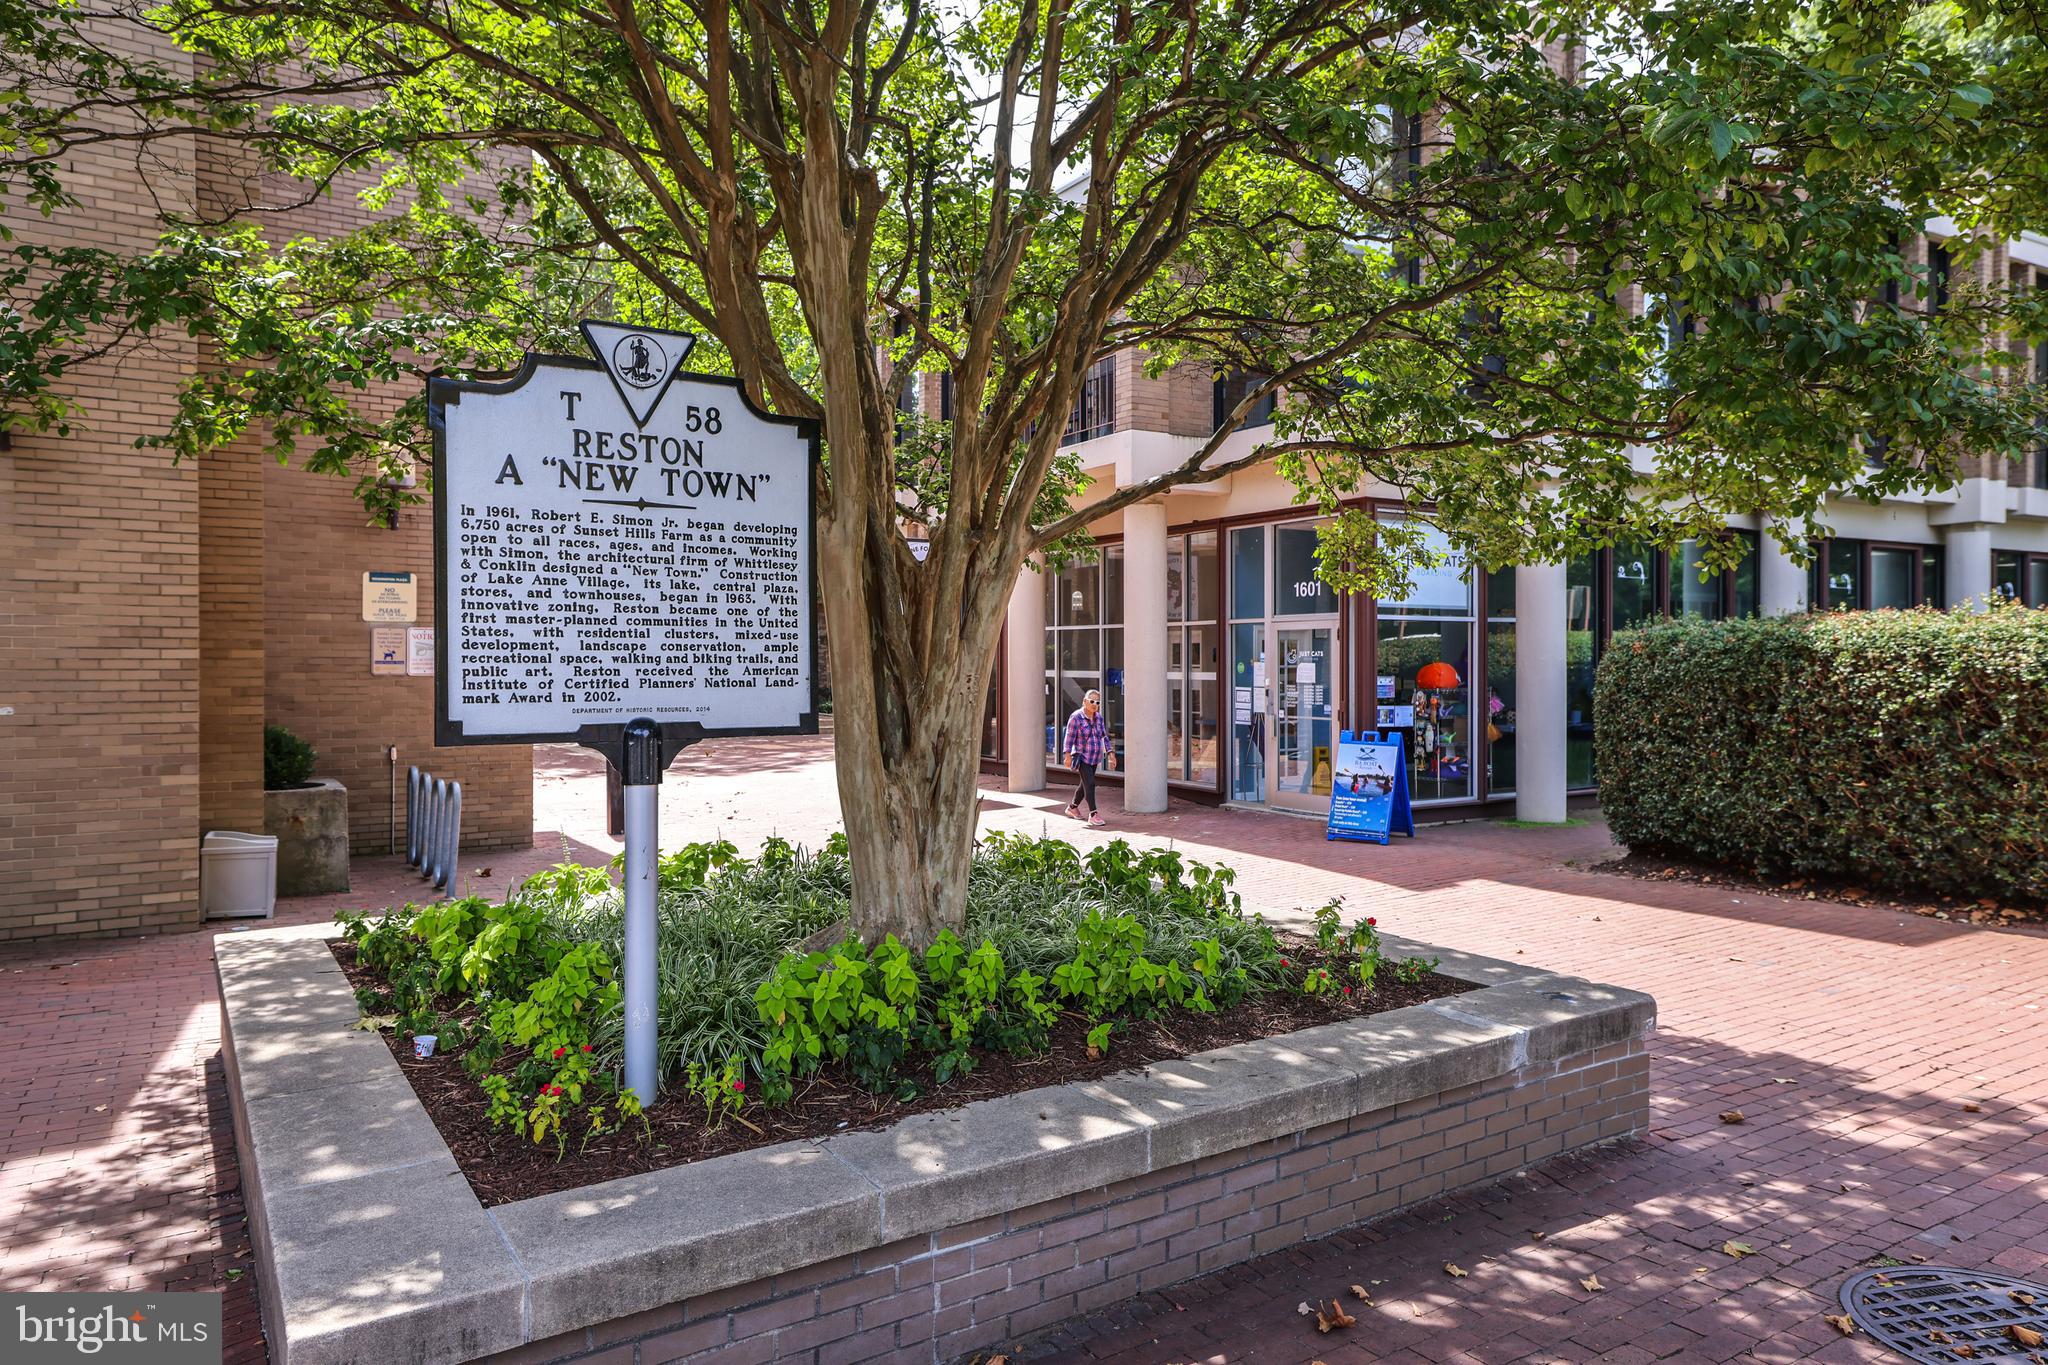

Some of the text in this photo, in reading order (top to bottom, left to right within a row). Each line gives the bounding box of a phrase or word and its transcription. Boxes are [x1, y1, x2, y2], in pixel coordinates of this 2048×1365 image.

[560, 391, 723, 435] T 58
[573, 428, 703, 468] RESTON
[495, 453, 771, 502] A "NEW TOWN"
[461, 504, 797, 537] In 1961, Robert E. Simon Jr. began developing
[461, 518, 797, 549] 6,750 acres of Sunset Hills Farm as a community
[461, 534, 798, 560] open to all races, ages, and incomes. Working
[460, 545, 798, 572] with Simon, the architectural firm of Whittlesey
[461, 558, 471, 569] &
[479, 558, 536, 572] Conklin
[542, 562, 603, 576] designed
[610, 567, 618, 575] a
[720, 569, 798, 582] Construction
[461, 572, 798, 594] of Lake Anne Village, its lake, central plaza,
[1294, 581, 1321, 597] 1601
[461, 586, 798, 605] stores, and townhouses, began in 1963. With
[461, 598, 798, 617] innovative zoning, Reston became one of the
[461, 612, 798, 629] first master-planned communities in the United
[462, 626, 798, 640] States, with residential clusters, mixed-use
[461, 638, 798, 654] development, landscape conservation, ample
[462, 652, 798, 666] recreational space, walking and biking trails, and
[462, 665, 799, 679] public art. Reston received the American
[462, 679, 527, 690] Institute
[538, 679, 554, 689] of
[564, 678, 629, 689] Certified
[704, 677, 756, 688] National
[765, 677, 799, 688] Land-
[462, 691, 621, 704] mark Award in 2002.
